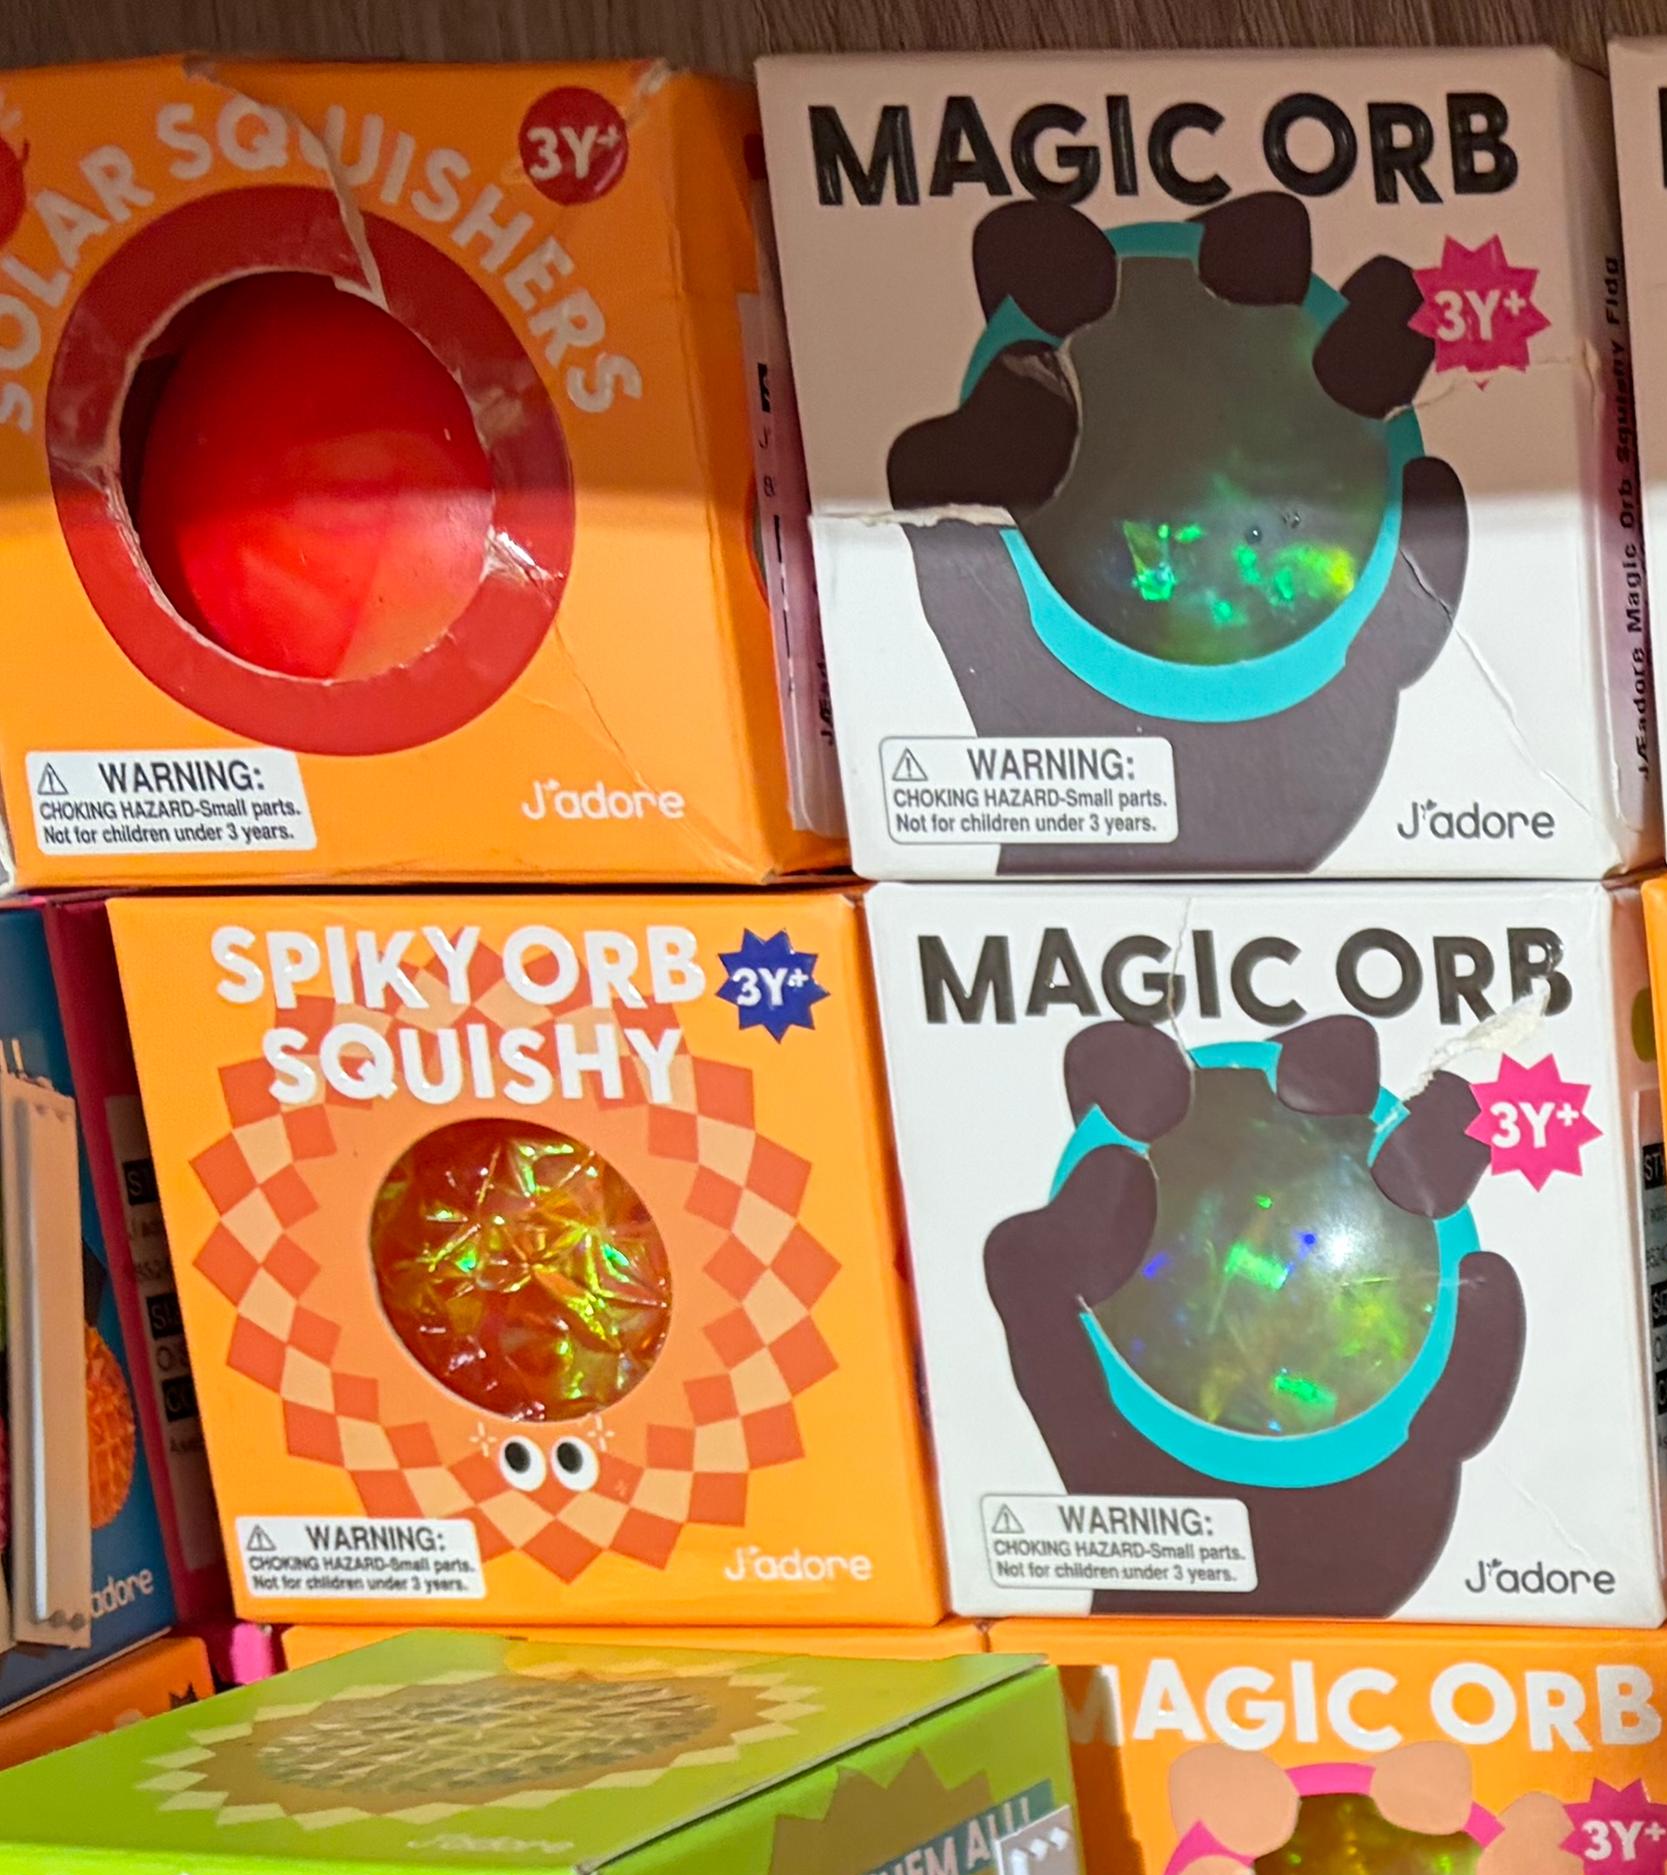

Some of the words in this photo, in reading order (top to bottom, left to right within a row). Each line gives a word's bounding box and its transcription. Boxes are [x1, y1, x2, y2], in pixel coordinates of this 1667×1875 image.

[808, 94, 1232, 206] MAGIC
[1263, 92, 1518, 204] ORB
[156, 95, 643, 414] SQUISHERS
[98, 760, 264, 792] WARNING:
[40, 802, 116, 821] CHOKING
[122, 798, 247, 818] HAZARD-Small
[253, 799, 301, 818] parts.
[45, 826, 70, 843] Not
[73, 825, 96, 843] for
[103, 824, 170, 842] children
[175, 823, 222, 841] under
[229, 824, 238, 839] 3
[242, 825, 294, 845] years.
[1397, 799, 1555, 841] J'adore
[209, 924, 481, 1010] SPIKY
[501, 924, 705, 1006] ORB
[918, 928, 1308, 1026] MAGIC
[1335, 926, 1574, 1026] ORB
[262, 1022, 683, 1104] SQUISHY
[724, 1546, 872, 1585] J'adore
